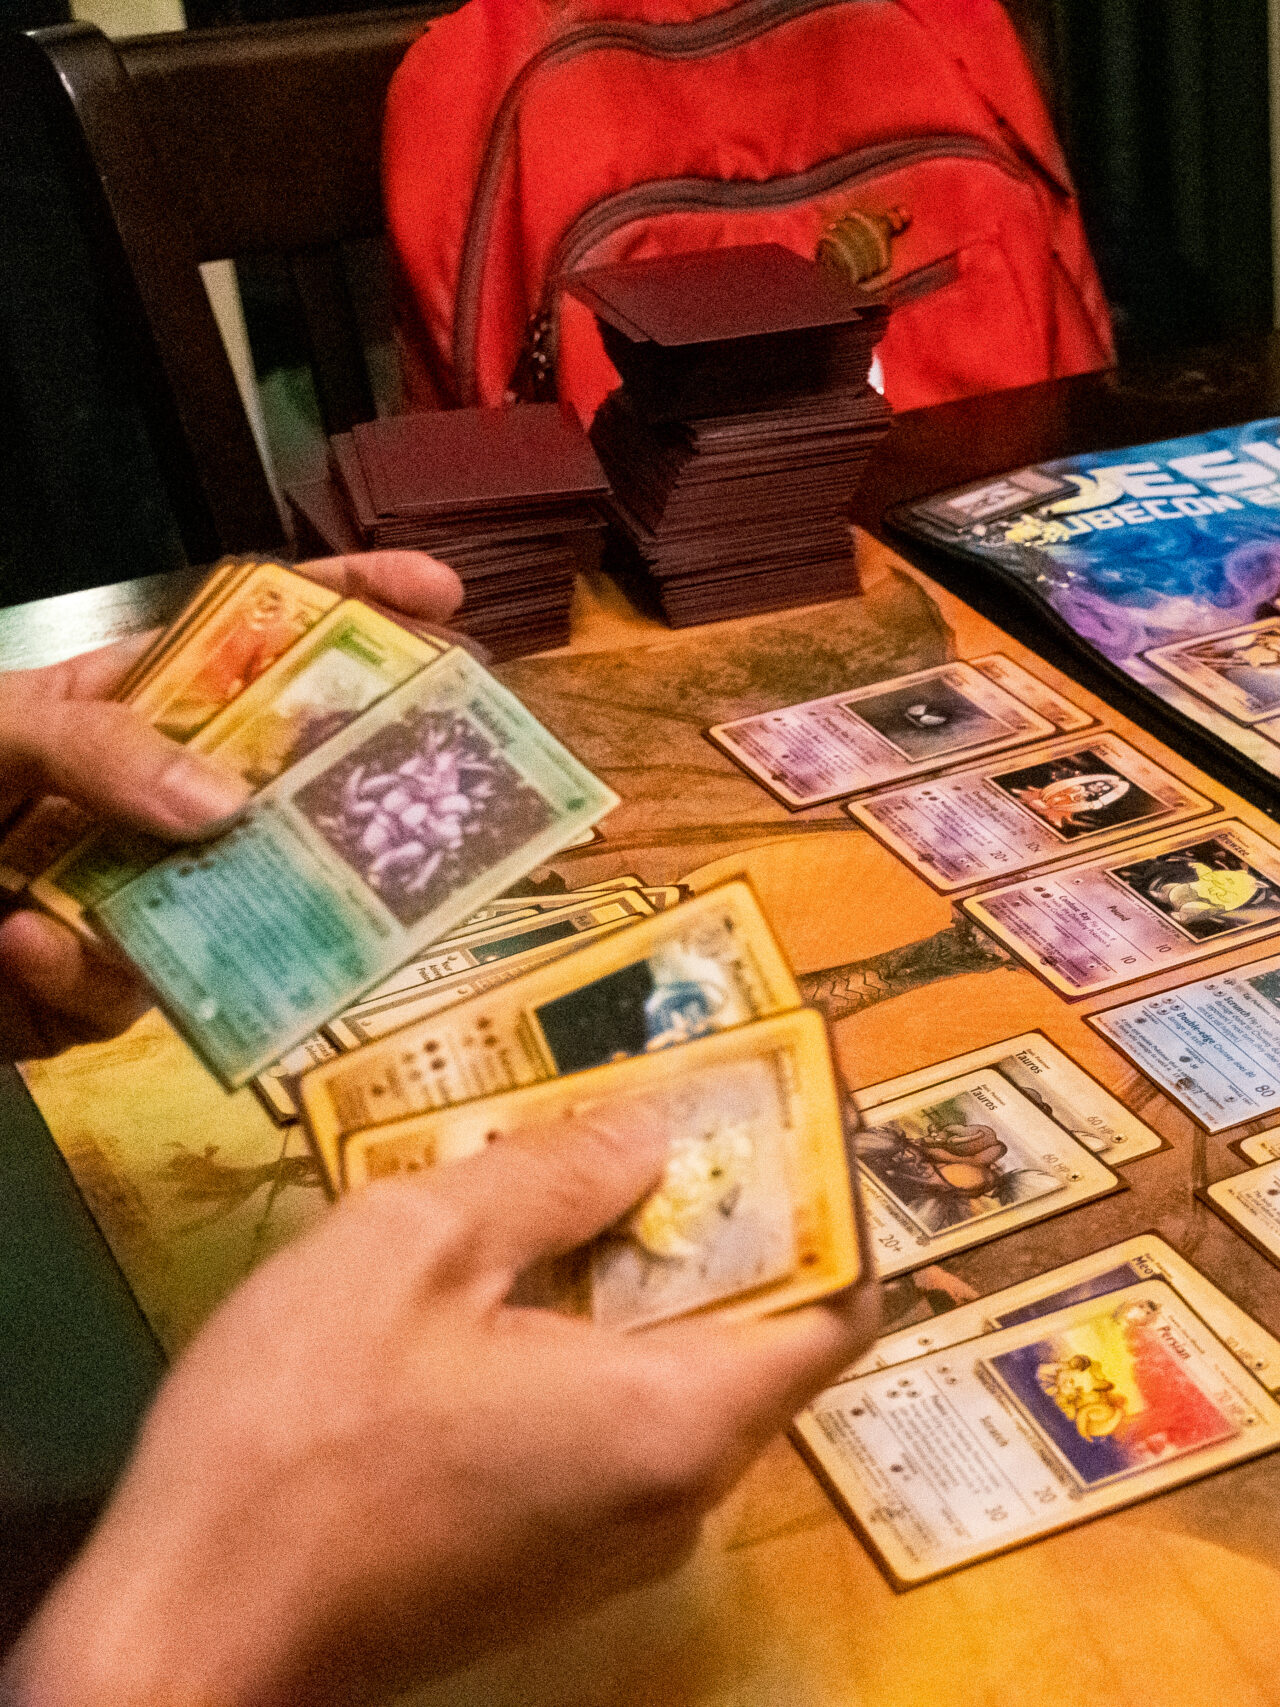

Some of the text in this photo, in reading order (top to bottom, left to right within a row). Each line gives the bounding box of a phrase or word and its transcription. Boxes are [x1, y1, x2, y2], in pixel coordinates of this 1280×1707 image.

[1062, 491, 1246, 537] UBECON
[988, 849, 1009, 862] 20+
[1215, 832, 1250, 856] Drowzee
[1058, 895, 1081, 912] Confuse
[1078, 911, 1091, 921] Ray
[1119, 954, 1137, 964] 10
[1106, 904, 1172, 953] Pound 10
[1222, 995, 1251, 1017] Scrunch
[1175, 1011, 1216, 1044] Double-edge
[1211, 1042, 1235, 1062] Chansey
[1253, 1084, 1276, 1097] 80
[1013, 1049, 1115, 1137] Tauros 60 HP
[967, 1084, 1071, 1176] Tauros 60 HP
[878, 1233, 904, 1253] 20+
[1157, 1325, 1191, 1360] Persian
